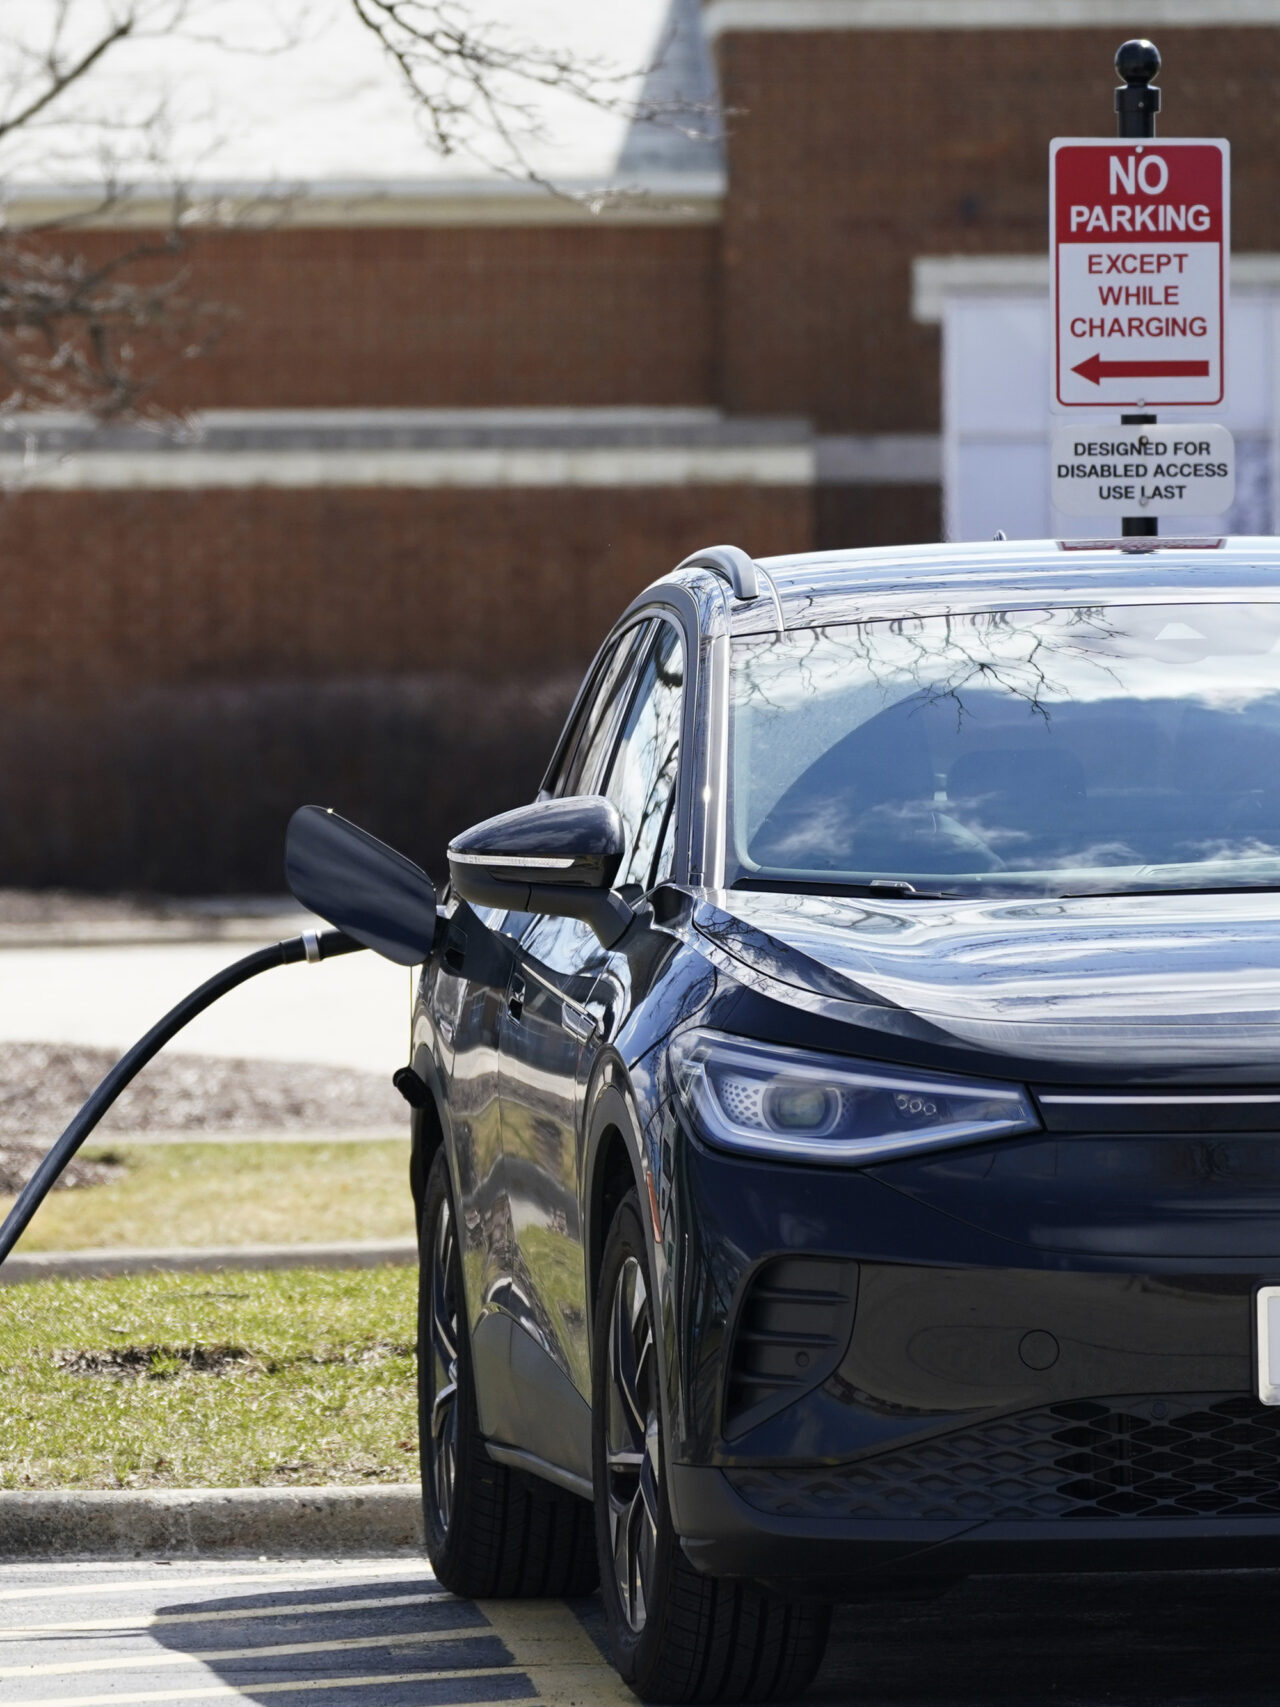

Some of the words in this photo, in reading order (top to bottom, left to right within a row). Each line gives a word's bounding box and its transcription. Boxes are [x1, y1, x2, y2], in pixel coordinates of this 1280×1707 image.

[1109, 155, 1169, 195] NO
[1070, 204, 1211, 232] PARKING
[1088, 253, 1189, 275] EXCEPT
[1098, 285, 1180, 306] WHILE
[1070, 316, 1208, 338] CHARGING
[1074, 442, 1168, 457] DESIGNED
[1173, 441, 1211, 456] FOR
[1057, 463, 1148, 479] DISABLED
[1153, 463, 1228, 478] ACCESS
[1098, 485, 1135, 500] USE
[1141, 485, 1187, 500] LAST
